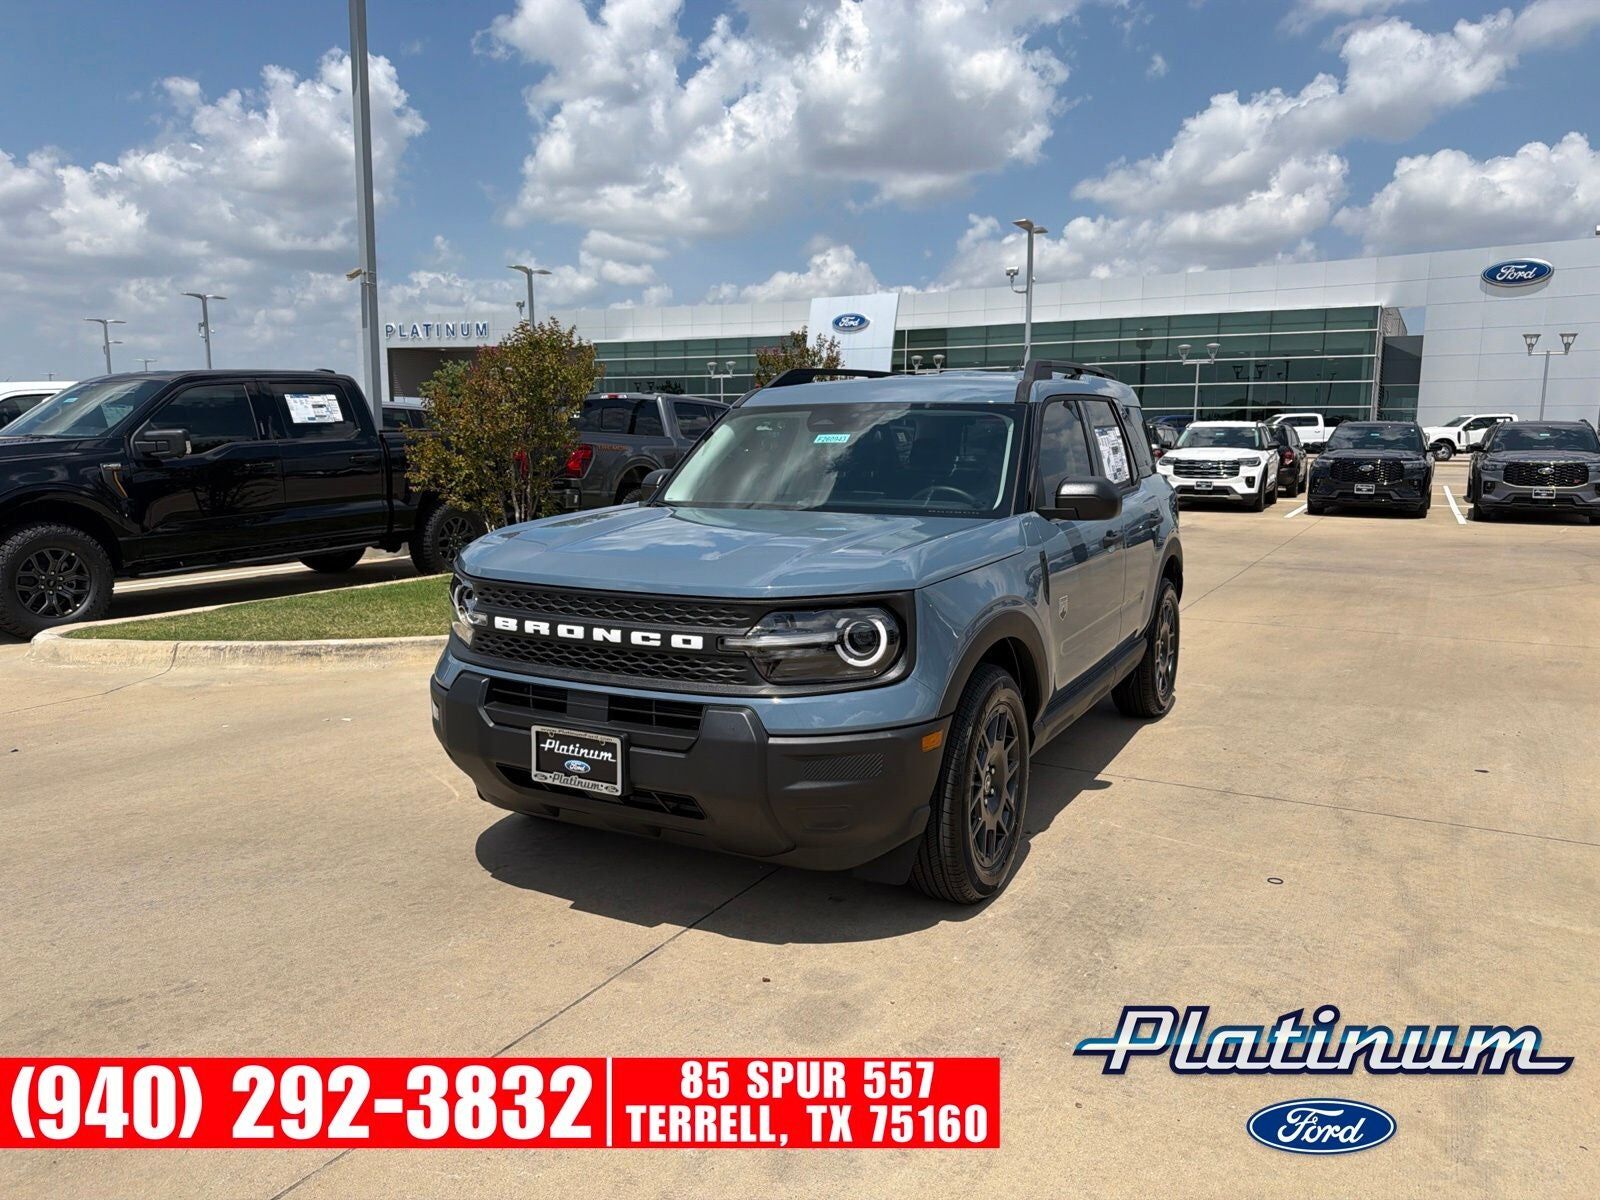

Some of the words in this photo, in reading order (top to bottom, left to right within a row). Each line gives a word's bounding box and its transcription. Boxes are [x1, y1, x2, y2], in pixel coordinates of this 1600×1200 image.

[1496, 264, 1538, 281] Ford
[384, 322, 488, 339] PLATINUM
[838, 316, 860, 327] Ford
[494, 616, 703, 650] BRONCO
[540, 738, 617, 762] Platinum
[551, 771, 604, 791] Platinum
